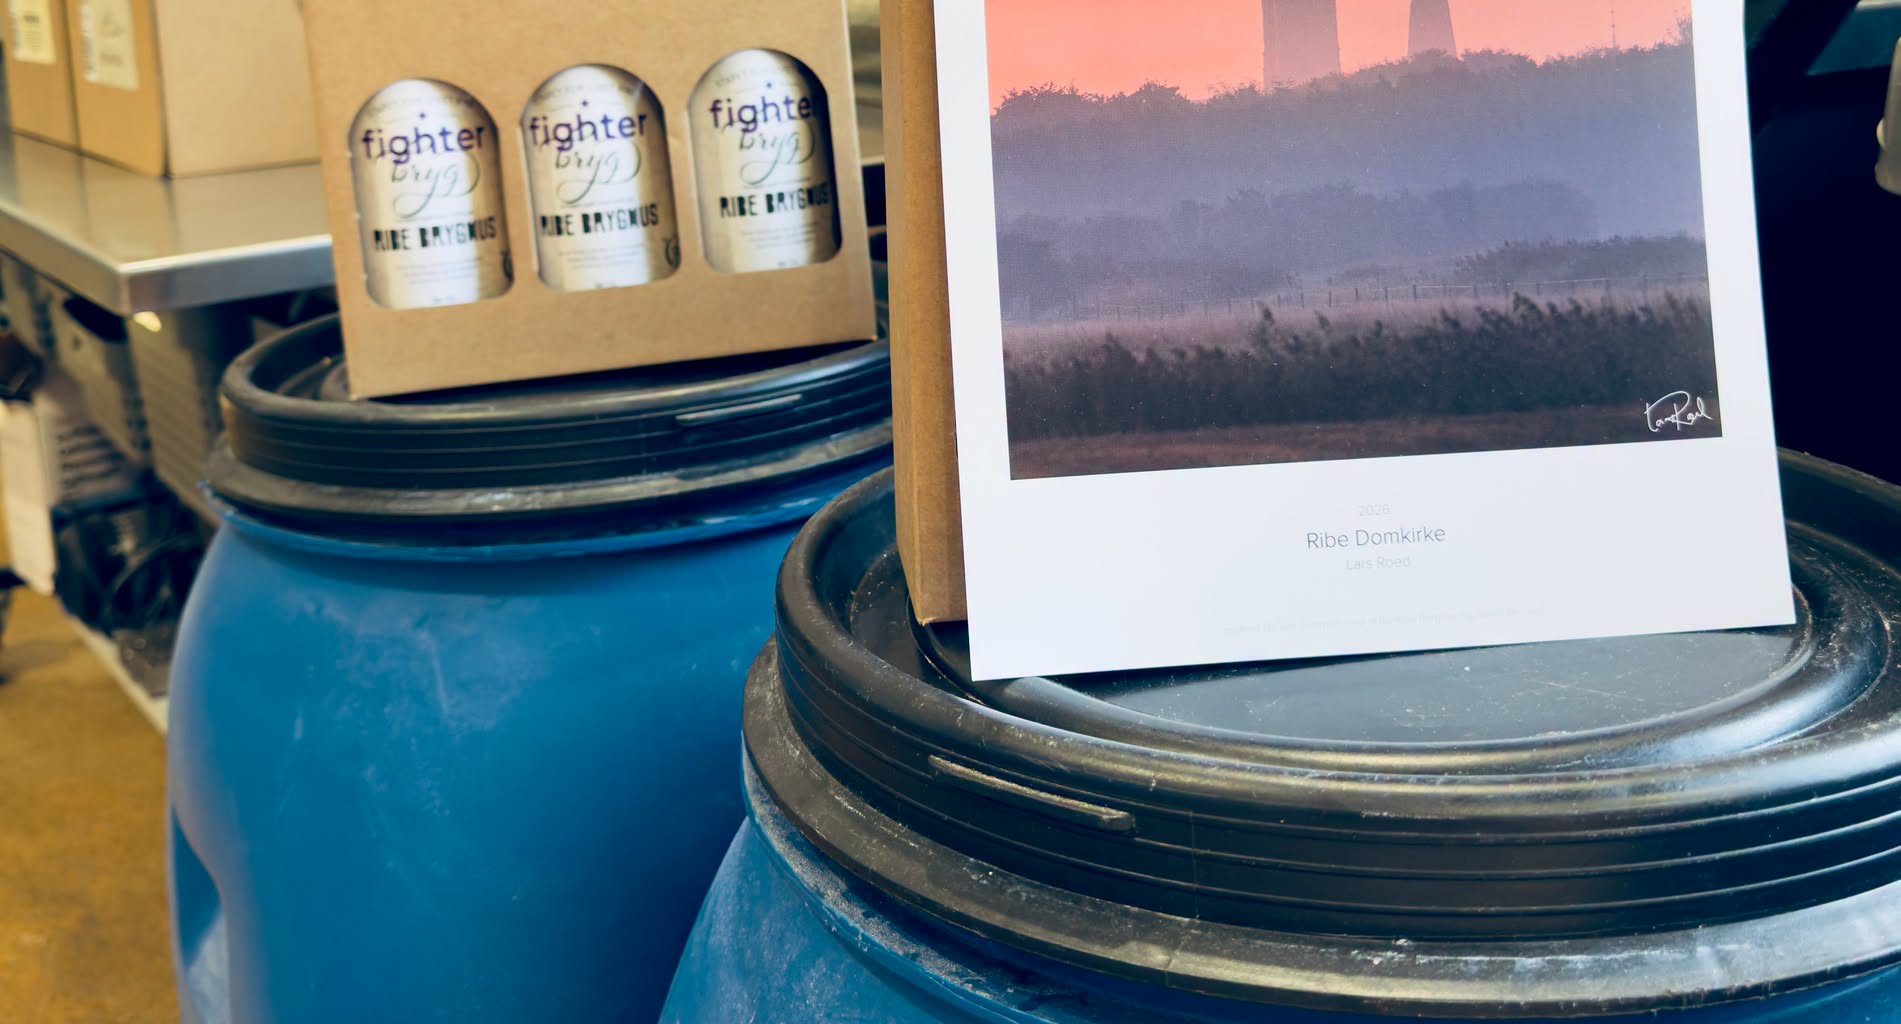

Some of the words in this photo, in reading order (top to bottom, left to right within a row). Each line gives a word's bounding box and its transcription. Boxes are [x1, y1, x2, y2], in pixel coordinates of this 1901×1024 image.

[361, 125, 485, 164] fighter
[529, 114, 648, 151] fighter
[540, 213, 574, 236] RIBE
[582, 203, 659, 233] BRYGHUS
[719, 194, 758, 218] RIBE
[374, 228, 411, 251] RIBE
[419, 217, 497, 248] BRYGHUS
[1359, 503, 1391, 517] 2026
[1306, 532, 1349, 549] Ribe
[1356, 526, 1446, 547] Domkirke
[1345, 558, 1373, 571] Lars
[1376, 555, 1411, 569] Roed
